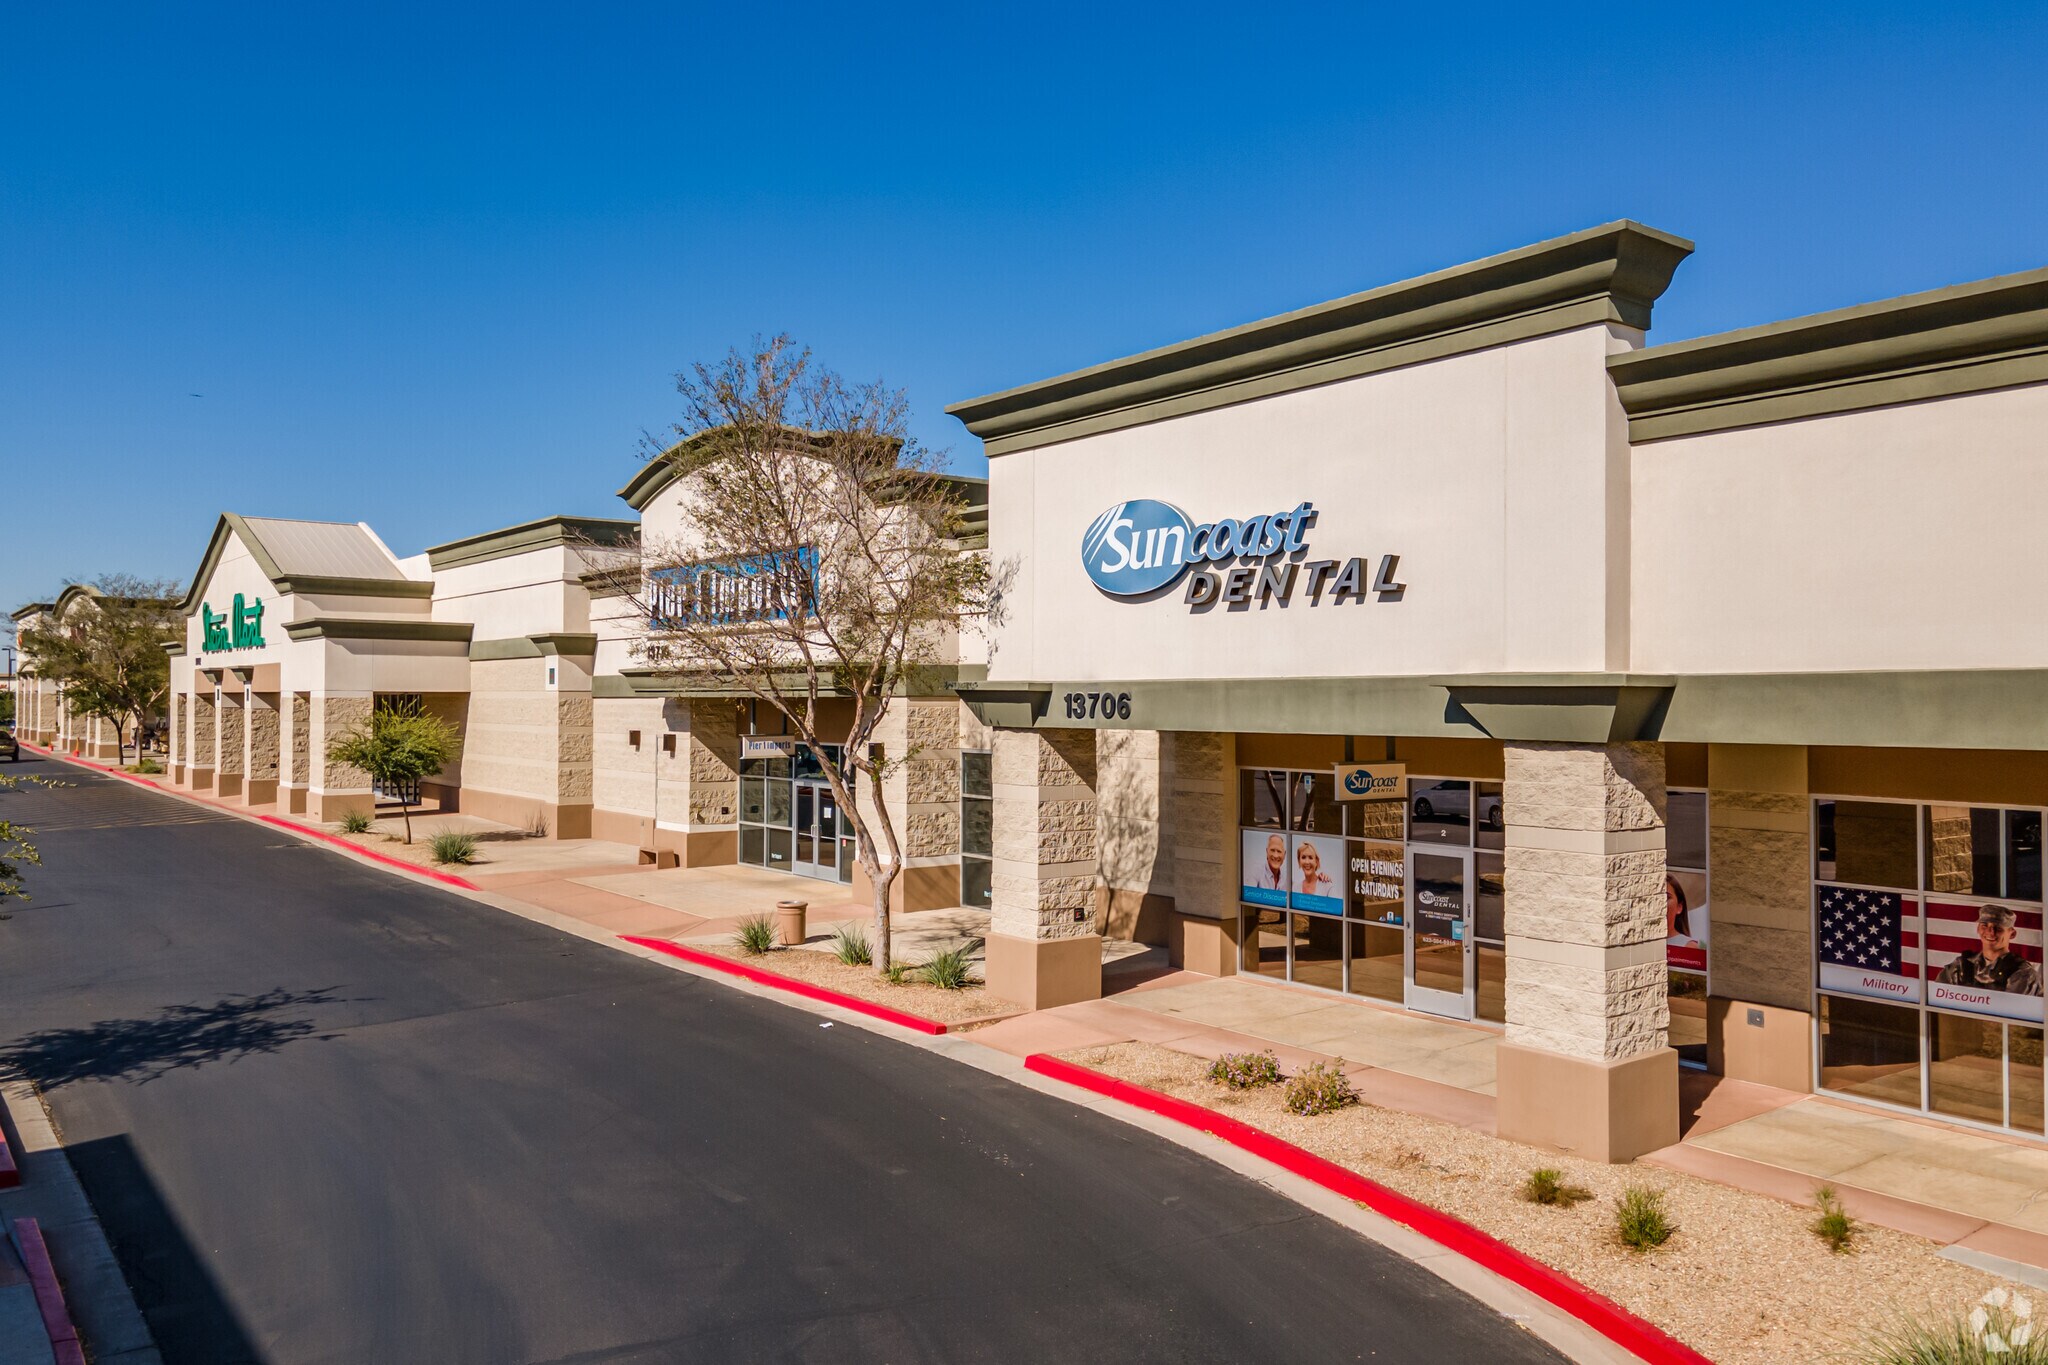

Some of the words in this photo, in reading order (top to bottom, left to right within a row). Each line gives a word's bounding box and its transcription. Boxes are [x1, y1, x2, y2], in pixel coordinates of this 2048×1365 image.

[1100, 501, 1318, 574] Suncoast
[1184, 554, 1407, 606] DENTAL
[650, 577, 687, 620] Pier
[1063, 691, 1132, 720] 13706
[748, 740, 762, 750] Pier
[1350, 773, 1399, 790] Suncoast
[1440, 829, 1447, 837] 2
[1351, 857, 1369, 873] OPEN
[1370, 860, 1404, 878] EVENINGS
[1354, 879, 1361, 894] &
[1360, 880, 1400, 900] SATURDAYS
[1433, 901, 1460, 910] DENTAL
[1667, 956, 1702, 967] ppointments
[1862, 977, 1909, 995] Military
[1935, 988, 1991, 1005] Discount
